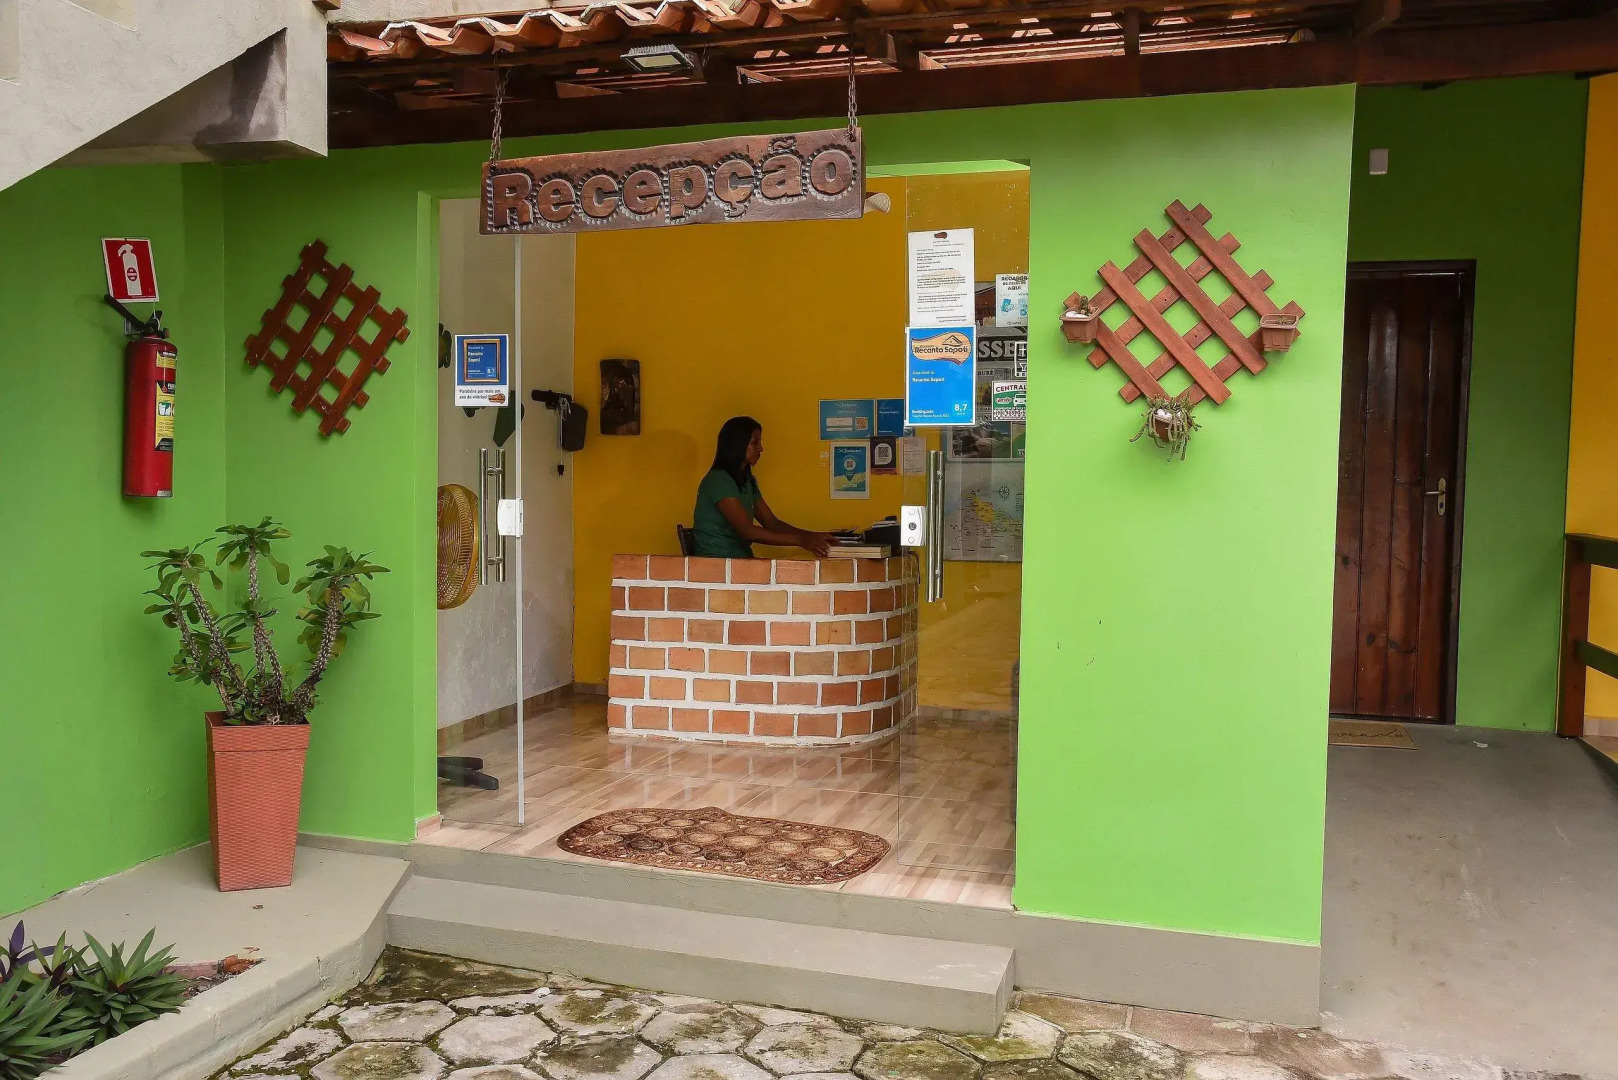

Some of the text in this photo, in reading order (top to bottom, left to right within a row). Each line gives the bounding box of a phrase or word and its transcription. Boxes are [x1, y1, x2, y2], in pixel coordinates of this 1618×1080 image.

[487, 135, 858, 231] Recepção
[914, 345, 968, 354] Recanto Sapoti
[996, 385, 1027, 393] CENTRAL
